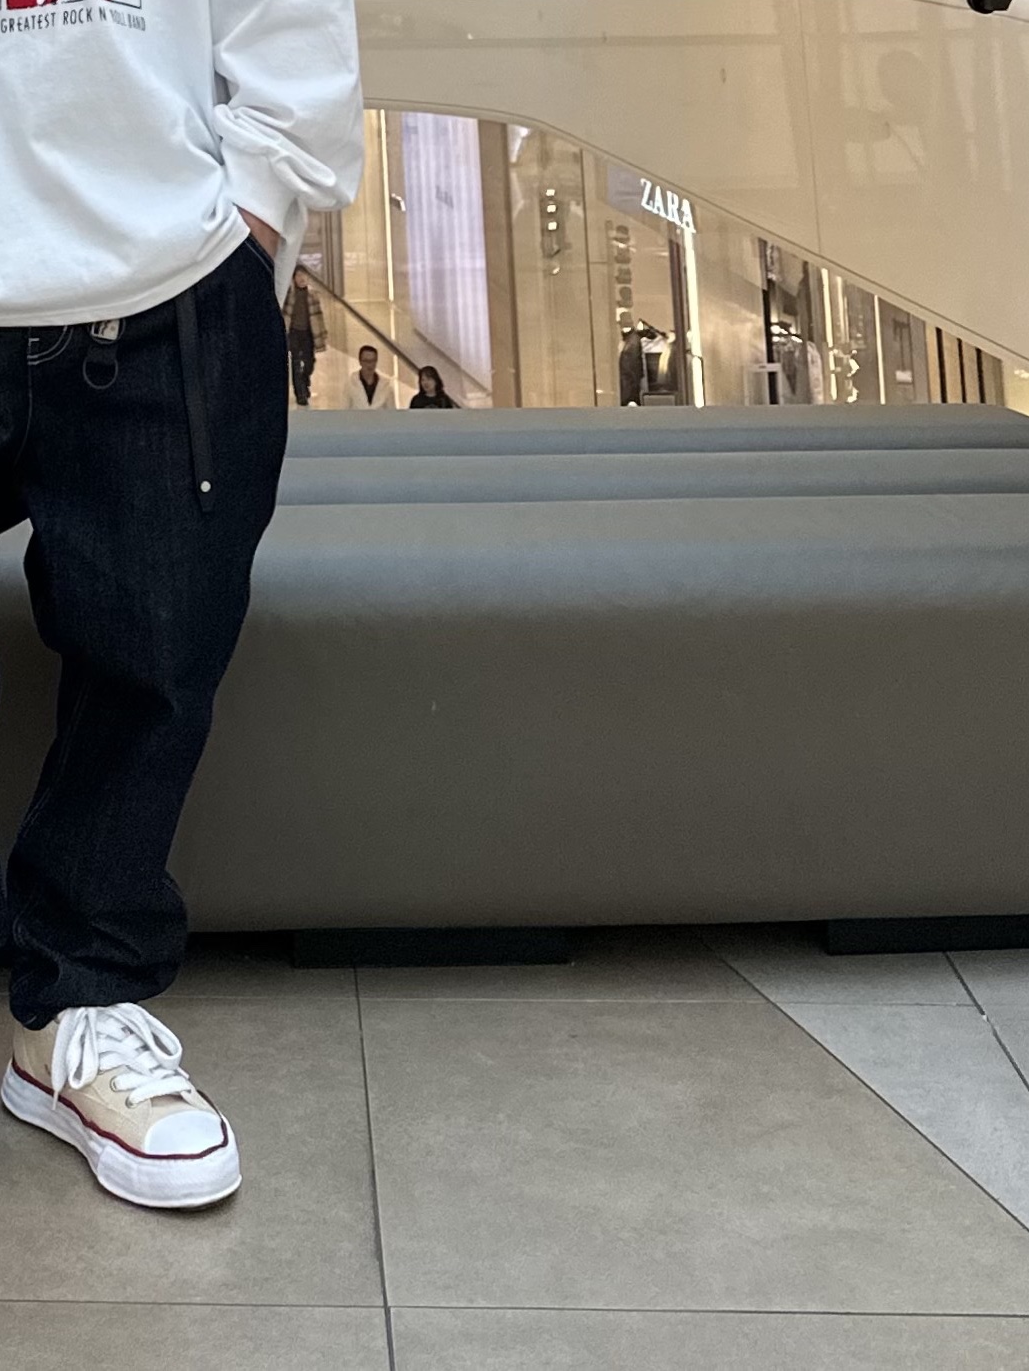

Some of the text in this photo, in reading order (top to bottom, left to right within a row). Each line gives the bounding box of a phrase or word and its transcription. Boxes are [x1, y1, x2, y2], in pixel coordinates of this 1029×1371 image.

[0, 11, 57, 33] GREATEST
[63, 7, 93, 25] ROCK
[640, 178, 697, 234] ZARA
